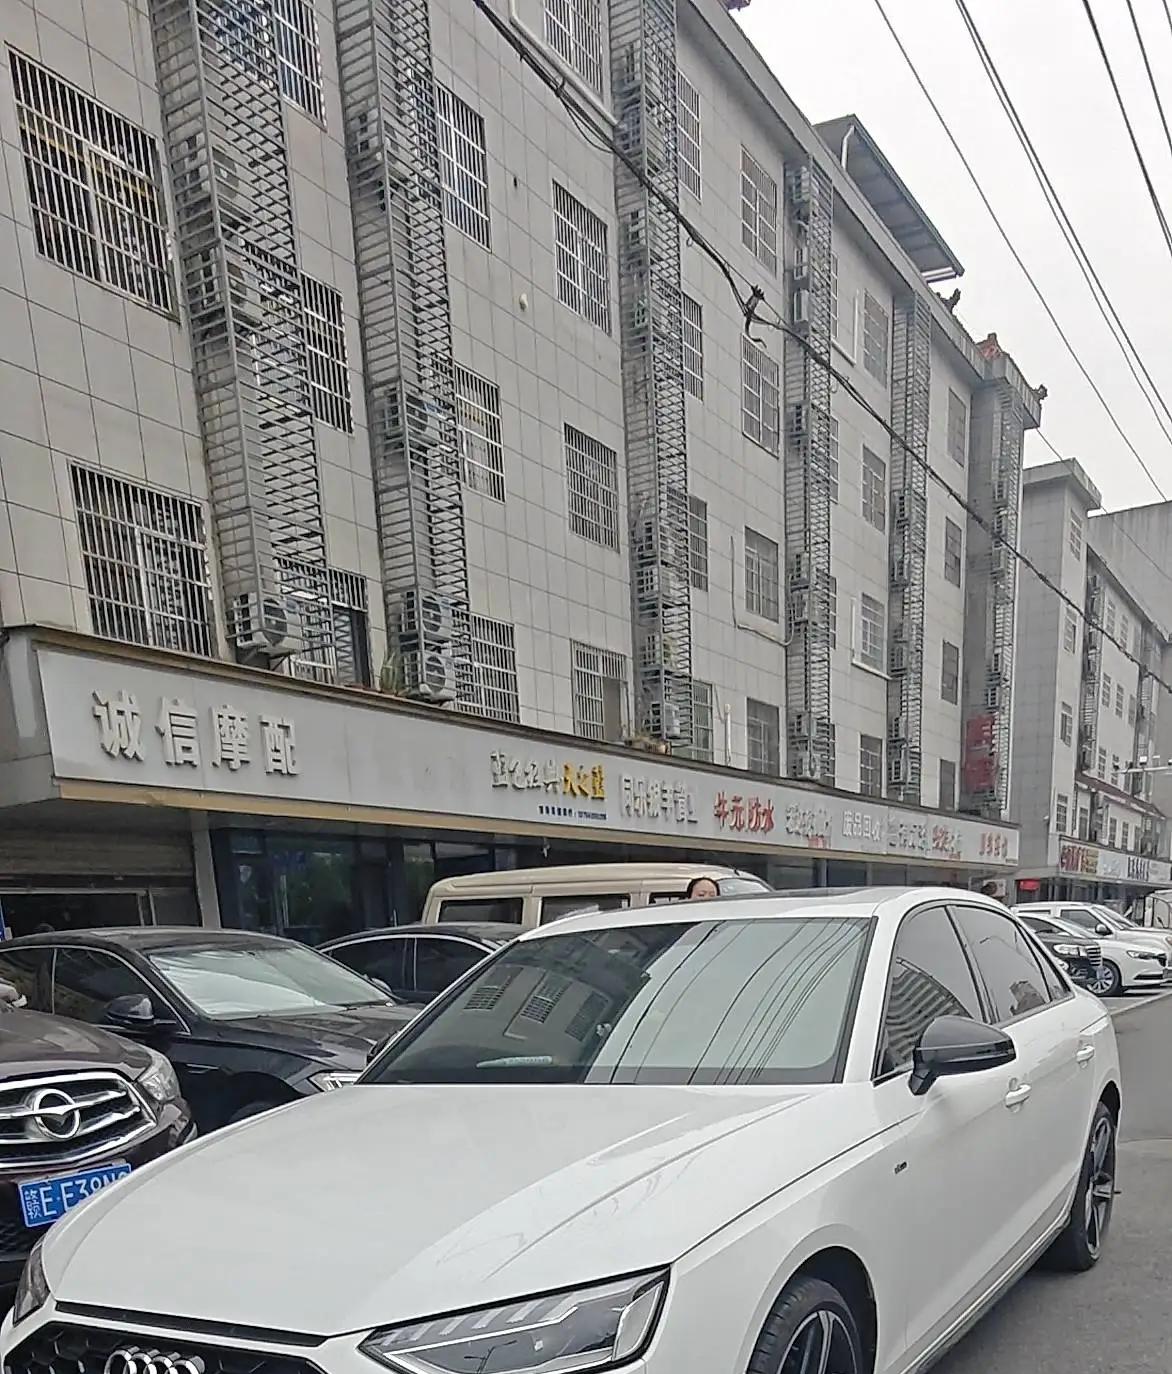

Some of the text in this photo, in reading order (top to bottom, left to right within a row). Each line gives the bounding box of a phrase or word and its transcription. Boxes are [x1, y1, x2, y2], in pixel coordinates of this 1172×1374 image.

[92, 689, 298, 777] 诚信摩配
[713, 790, 775, 834] 牛元防水
